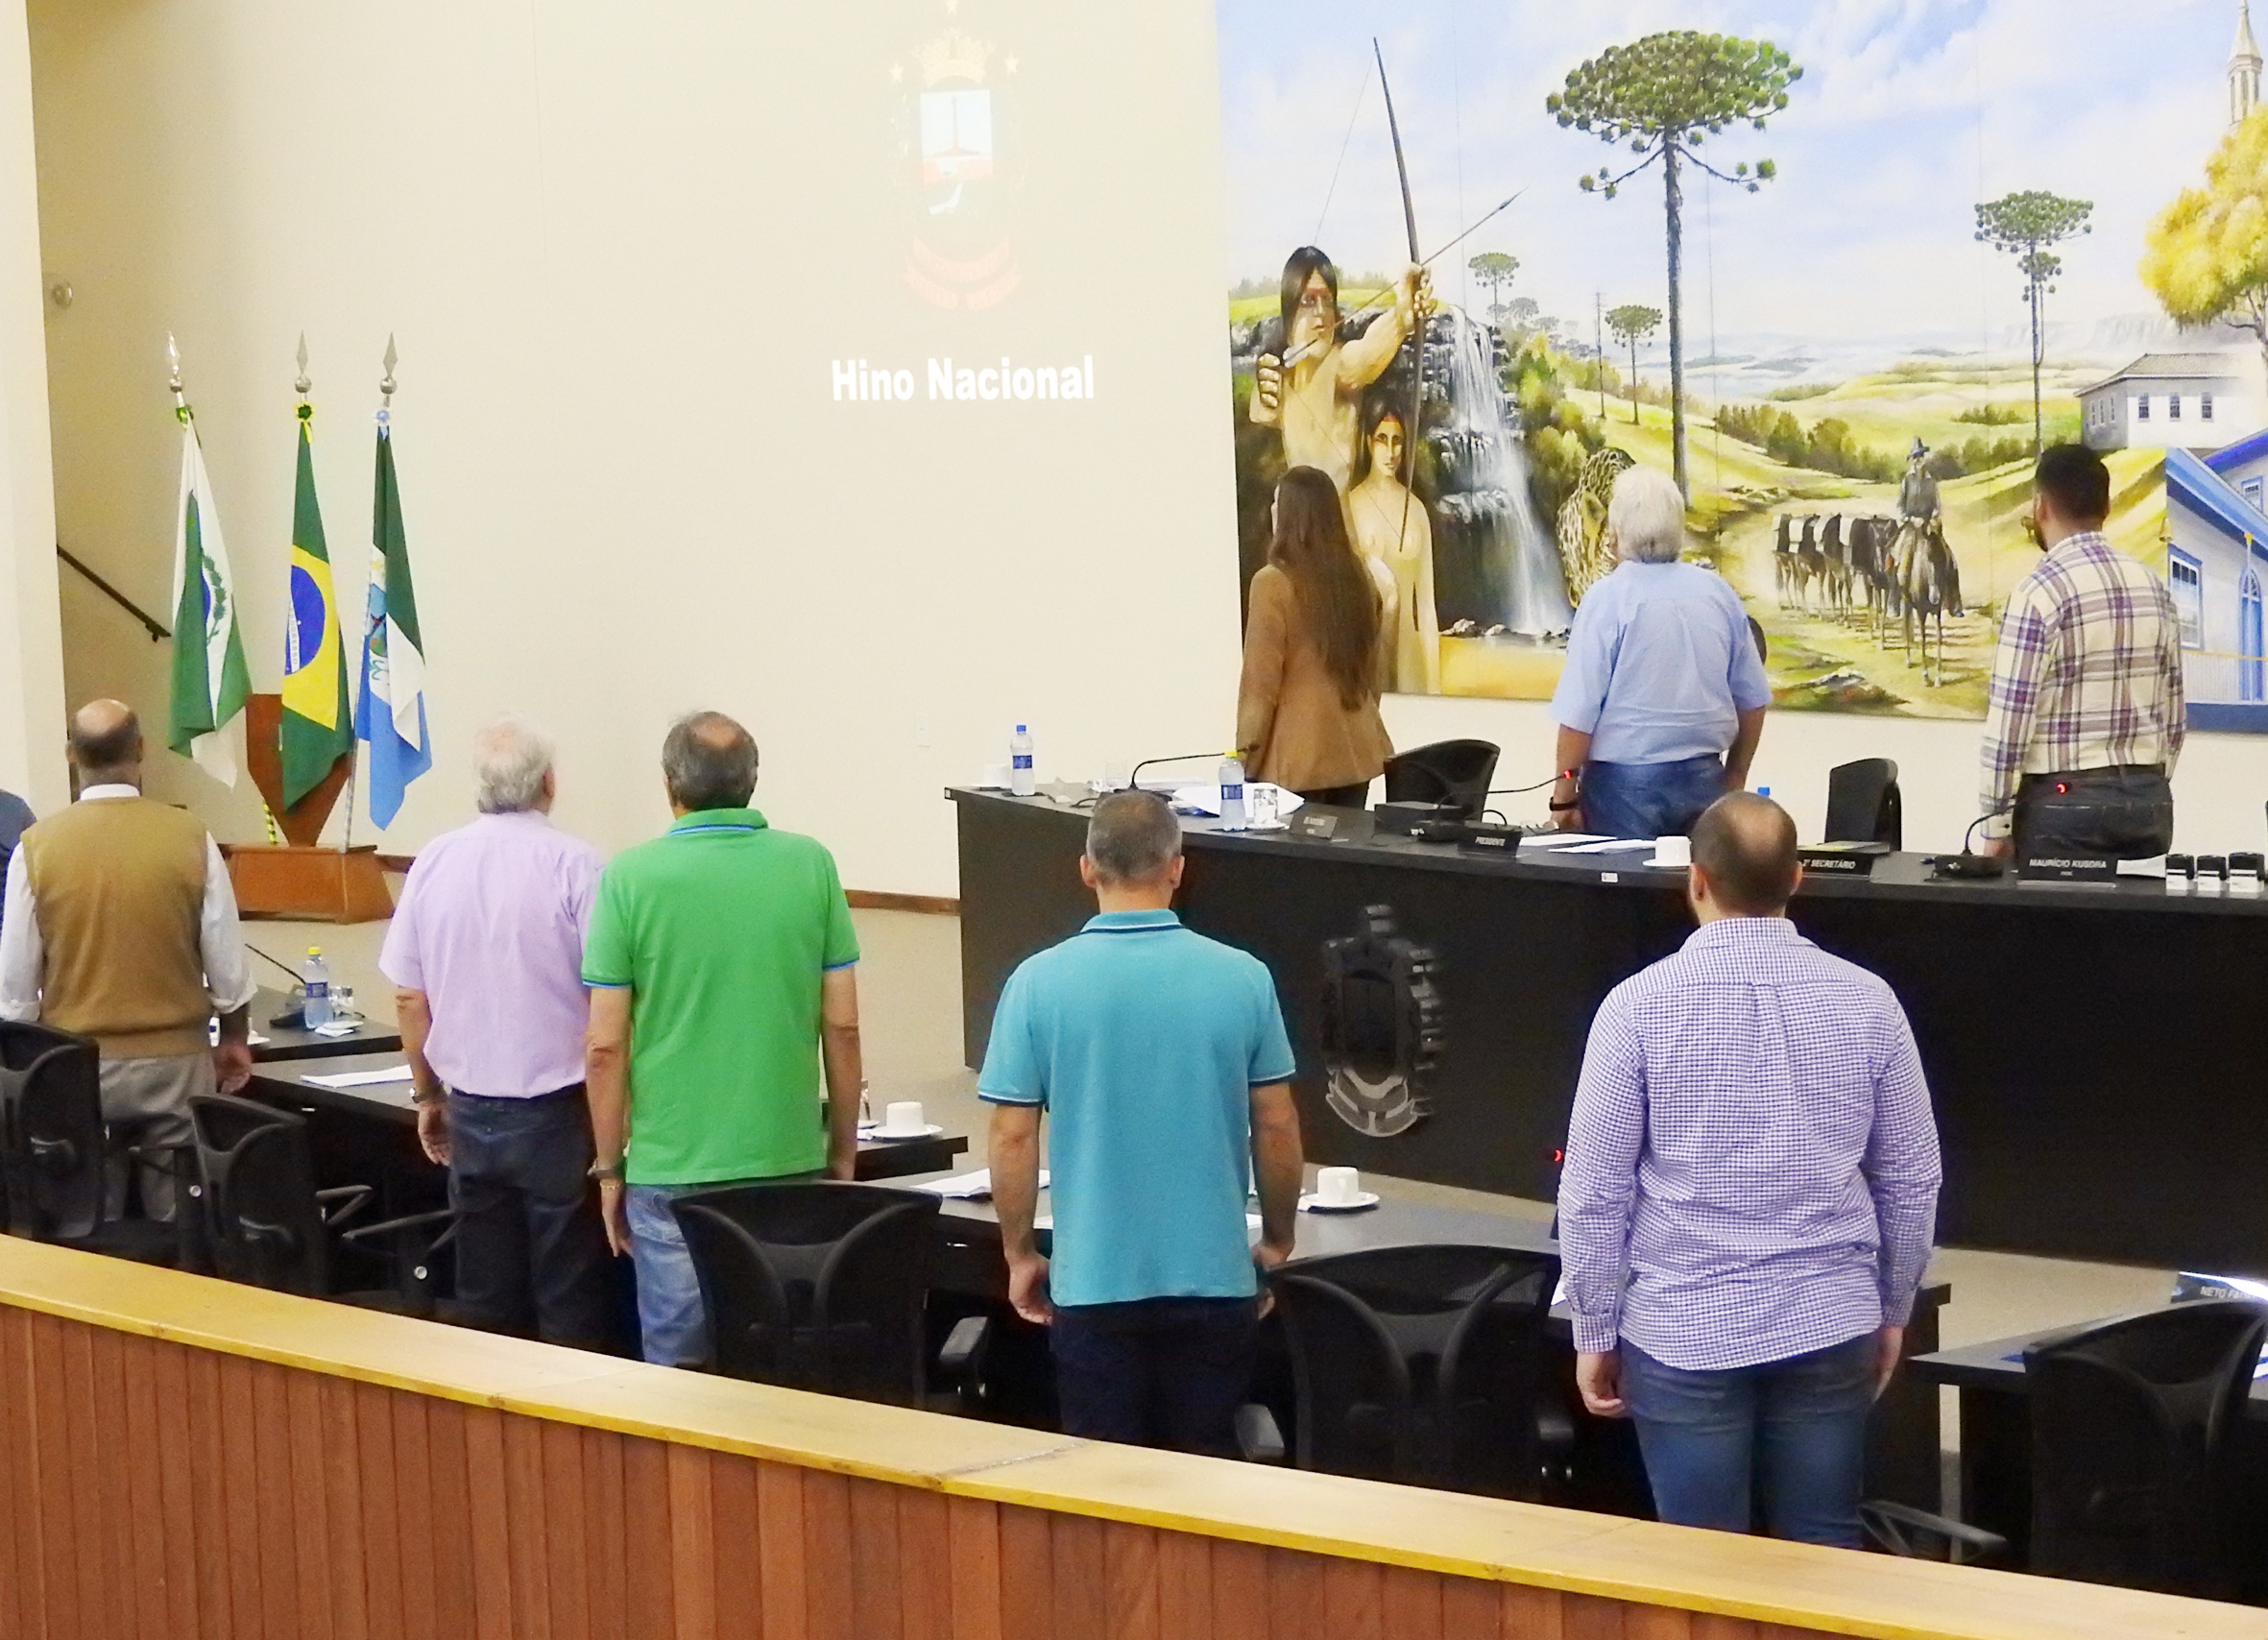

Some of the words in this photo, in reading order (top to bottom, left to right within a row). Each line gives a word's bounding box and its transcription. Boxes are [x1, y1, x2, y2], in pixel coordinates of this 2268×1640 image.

[832, 359, 914, 401] Hino
[928, 354, 1094, 400] Nacional
[1811, 858, 1856, 870] SECRETÁRIO
[2029, 857, 2071, 868] MAURÍCIO
[2200, 1286, 2227, 1298] NETO
